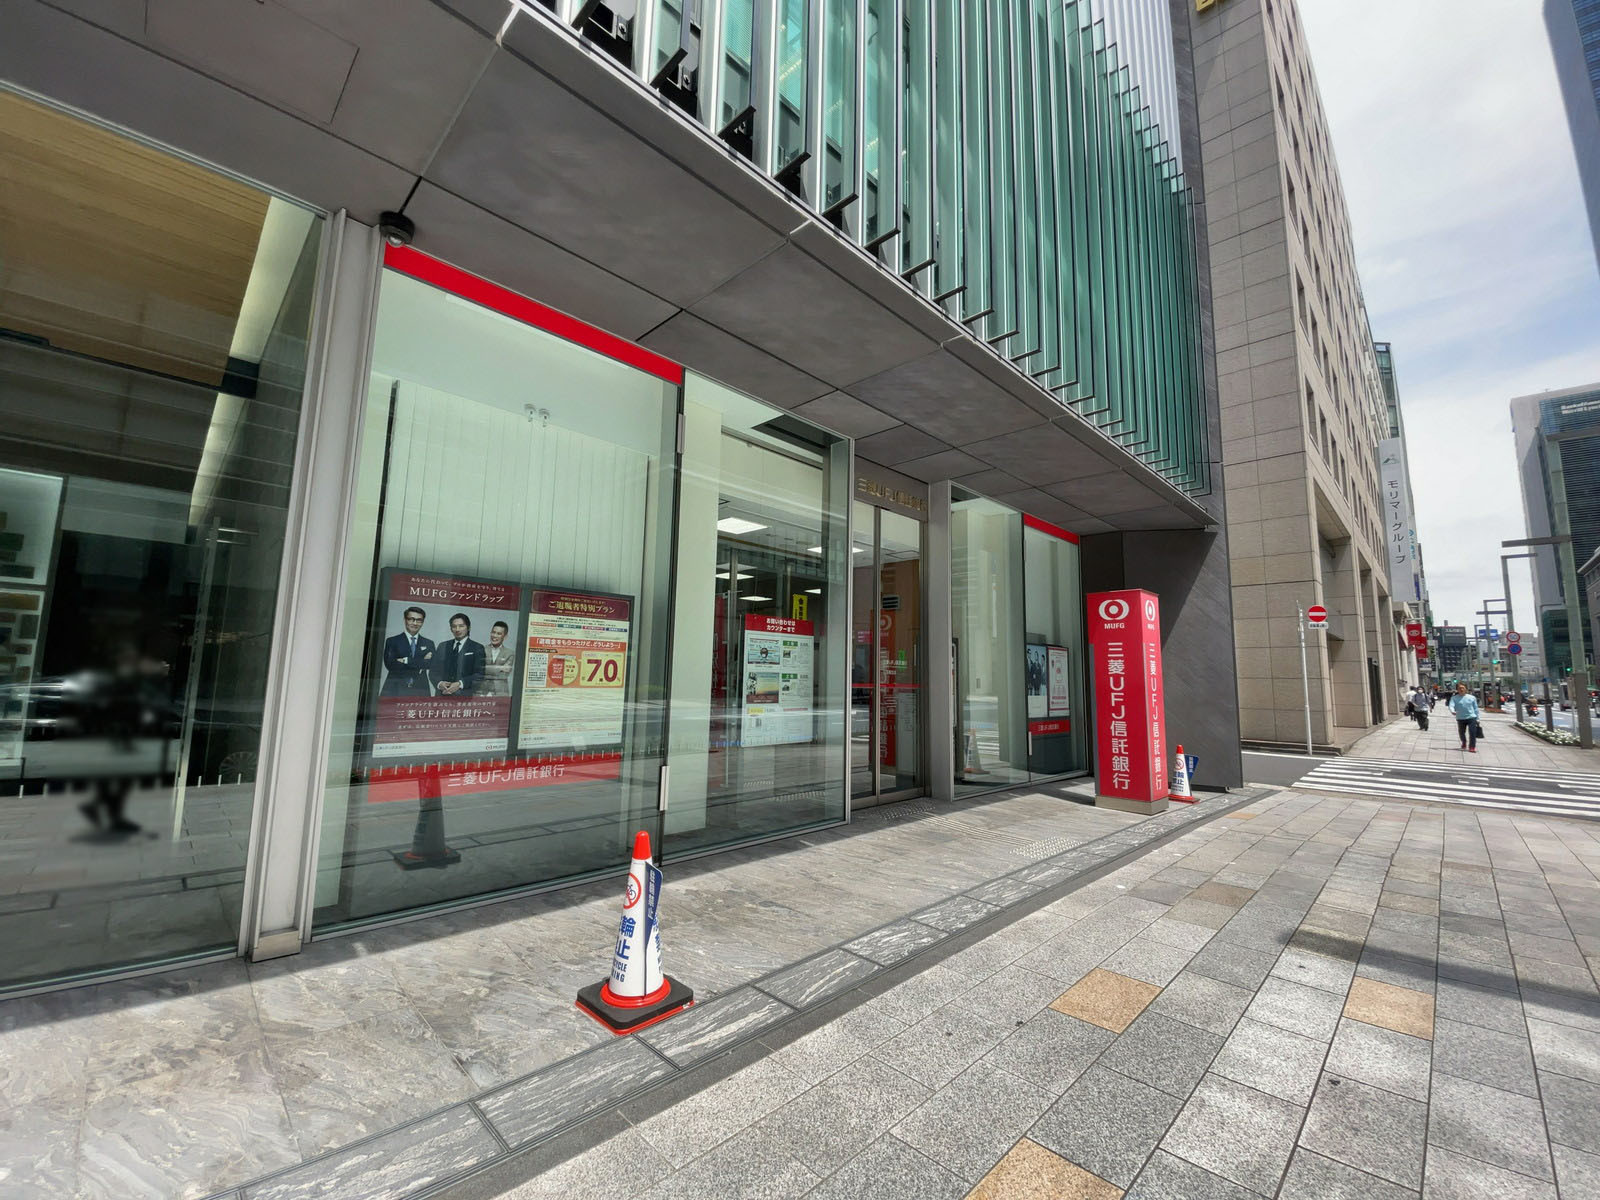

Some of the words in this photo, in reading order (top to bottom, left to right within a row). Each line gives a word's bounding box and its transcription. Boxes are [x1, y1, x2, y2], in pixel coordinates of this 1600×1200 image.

[1387, 480, 1406, 564] モリマーグループ
[548, 600, 616, 614] ご退職者特別プラン
[1104, 622, 1125, 630] MUFG
[586, 659, 619, 683] 7.0
[395, 708, 497, 719] 三菱UFJ信託銀行へ。
[1107, 642, 1131, 790] 三菱UFJ信託銀行
[1149, 642, 1163, 791] 三菱UFJ信託銀行
[447, 763, 566, 788] 三菱UFJ信託銀行
[619, 915, 636, 938] 輪
[615, 936, 631, 961] 止
